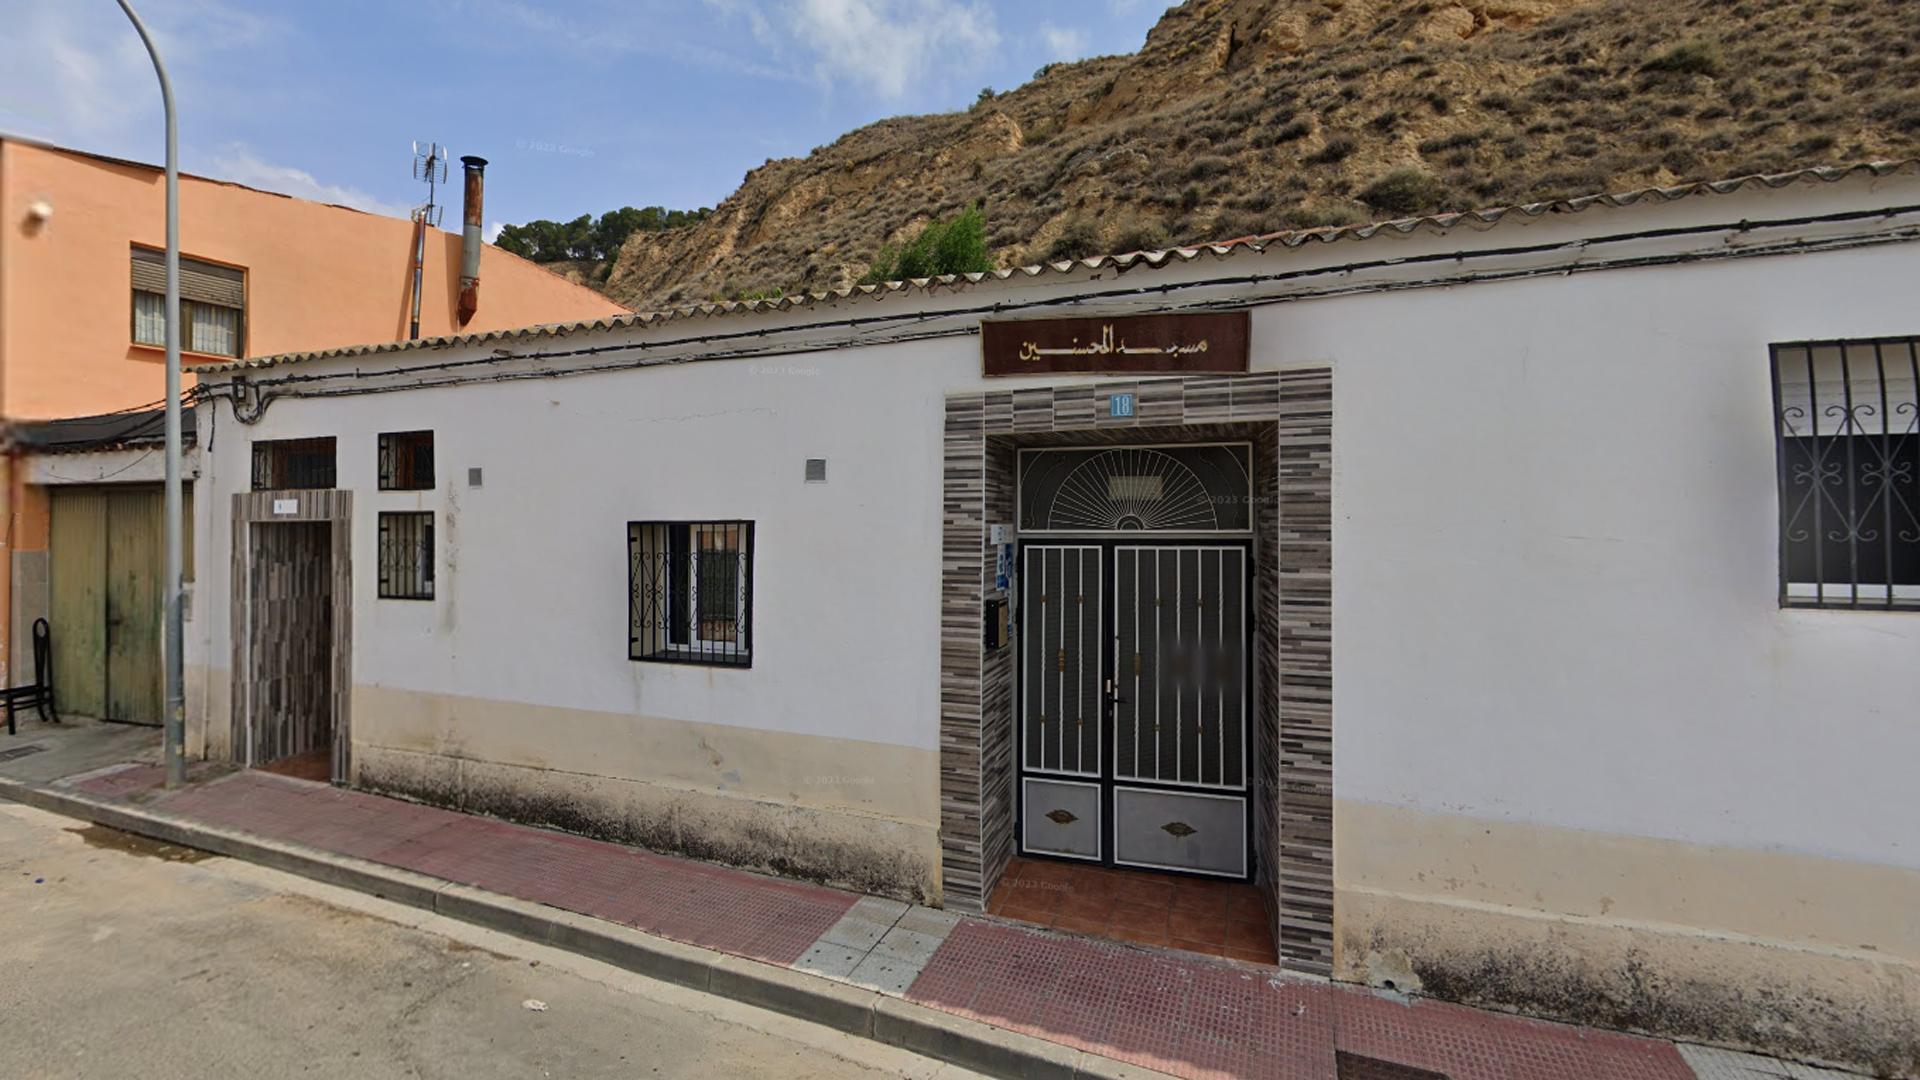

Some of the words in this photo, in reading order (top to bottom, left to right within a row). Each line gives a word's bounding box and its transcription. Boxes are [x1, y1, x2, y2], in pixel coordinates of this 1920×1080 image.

[1019, 323, 1115, 361] المحسنين
[1116, 338, 1209, 358] مسجد
[1115, 396, 1131, 416] 18
